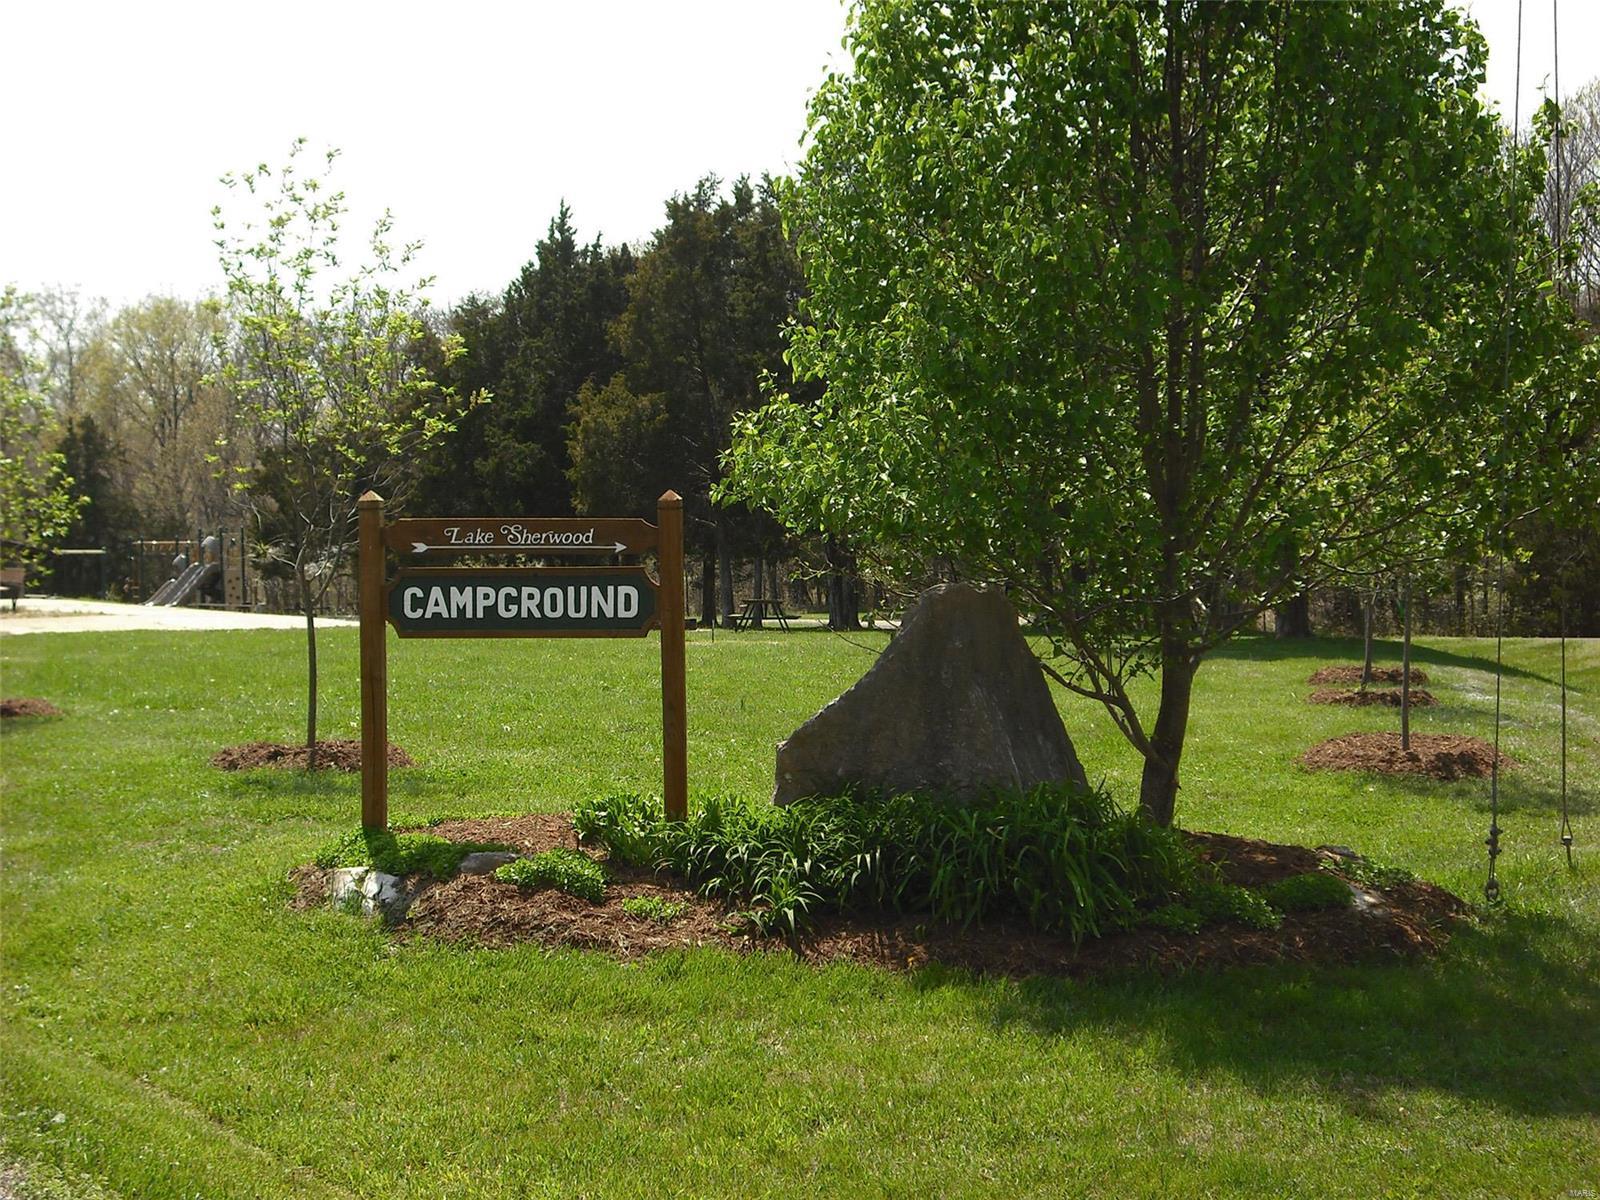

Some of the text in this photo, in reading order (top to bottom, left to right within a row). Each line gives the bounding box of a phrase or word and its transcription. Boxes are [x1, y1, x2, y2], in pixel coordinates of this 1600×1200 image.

[444, 524, 594, 545] Lake Sherwood
[403, 585, 639, 619] CAMPGROUND
